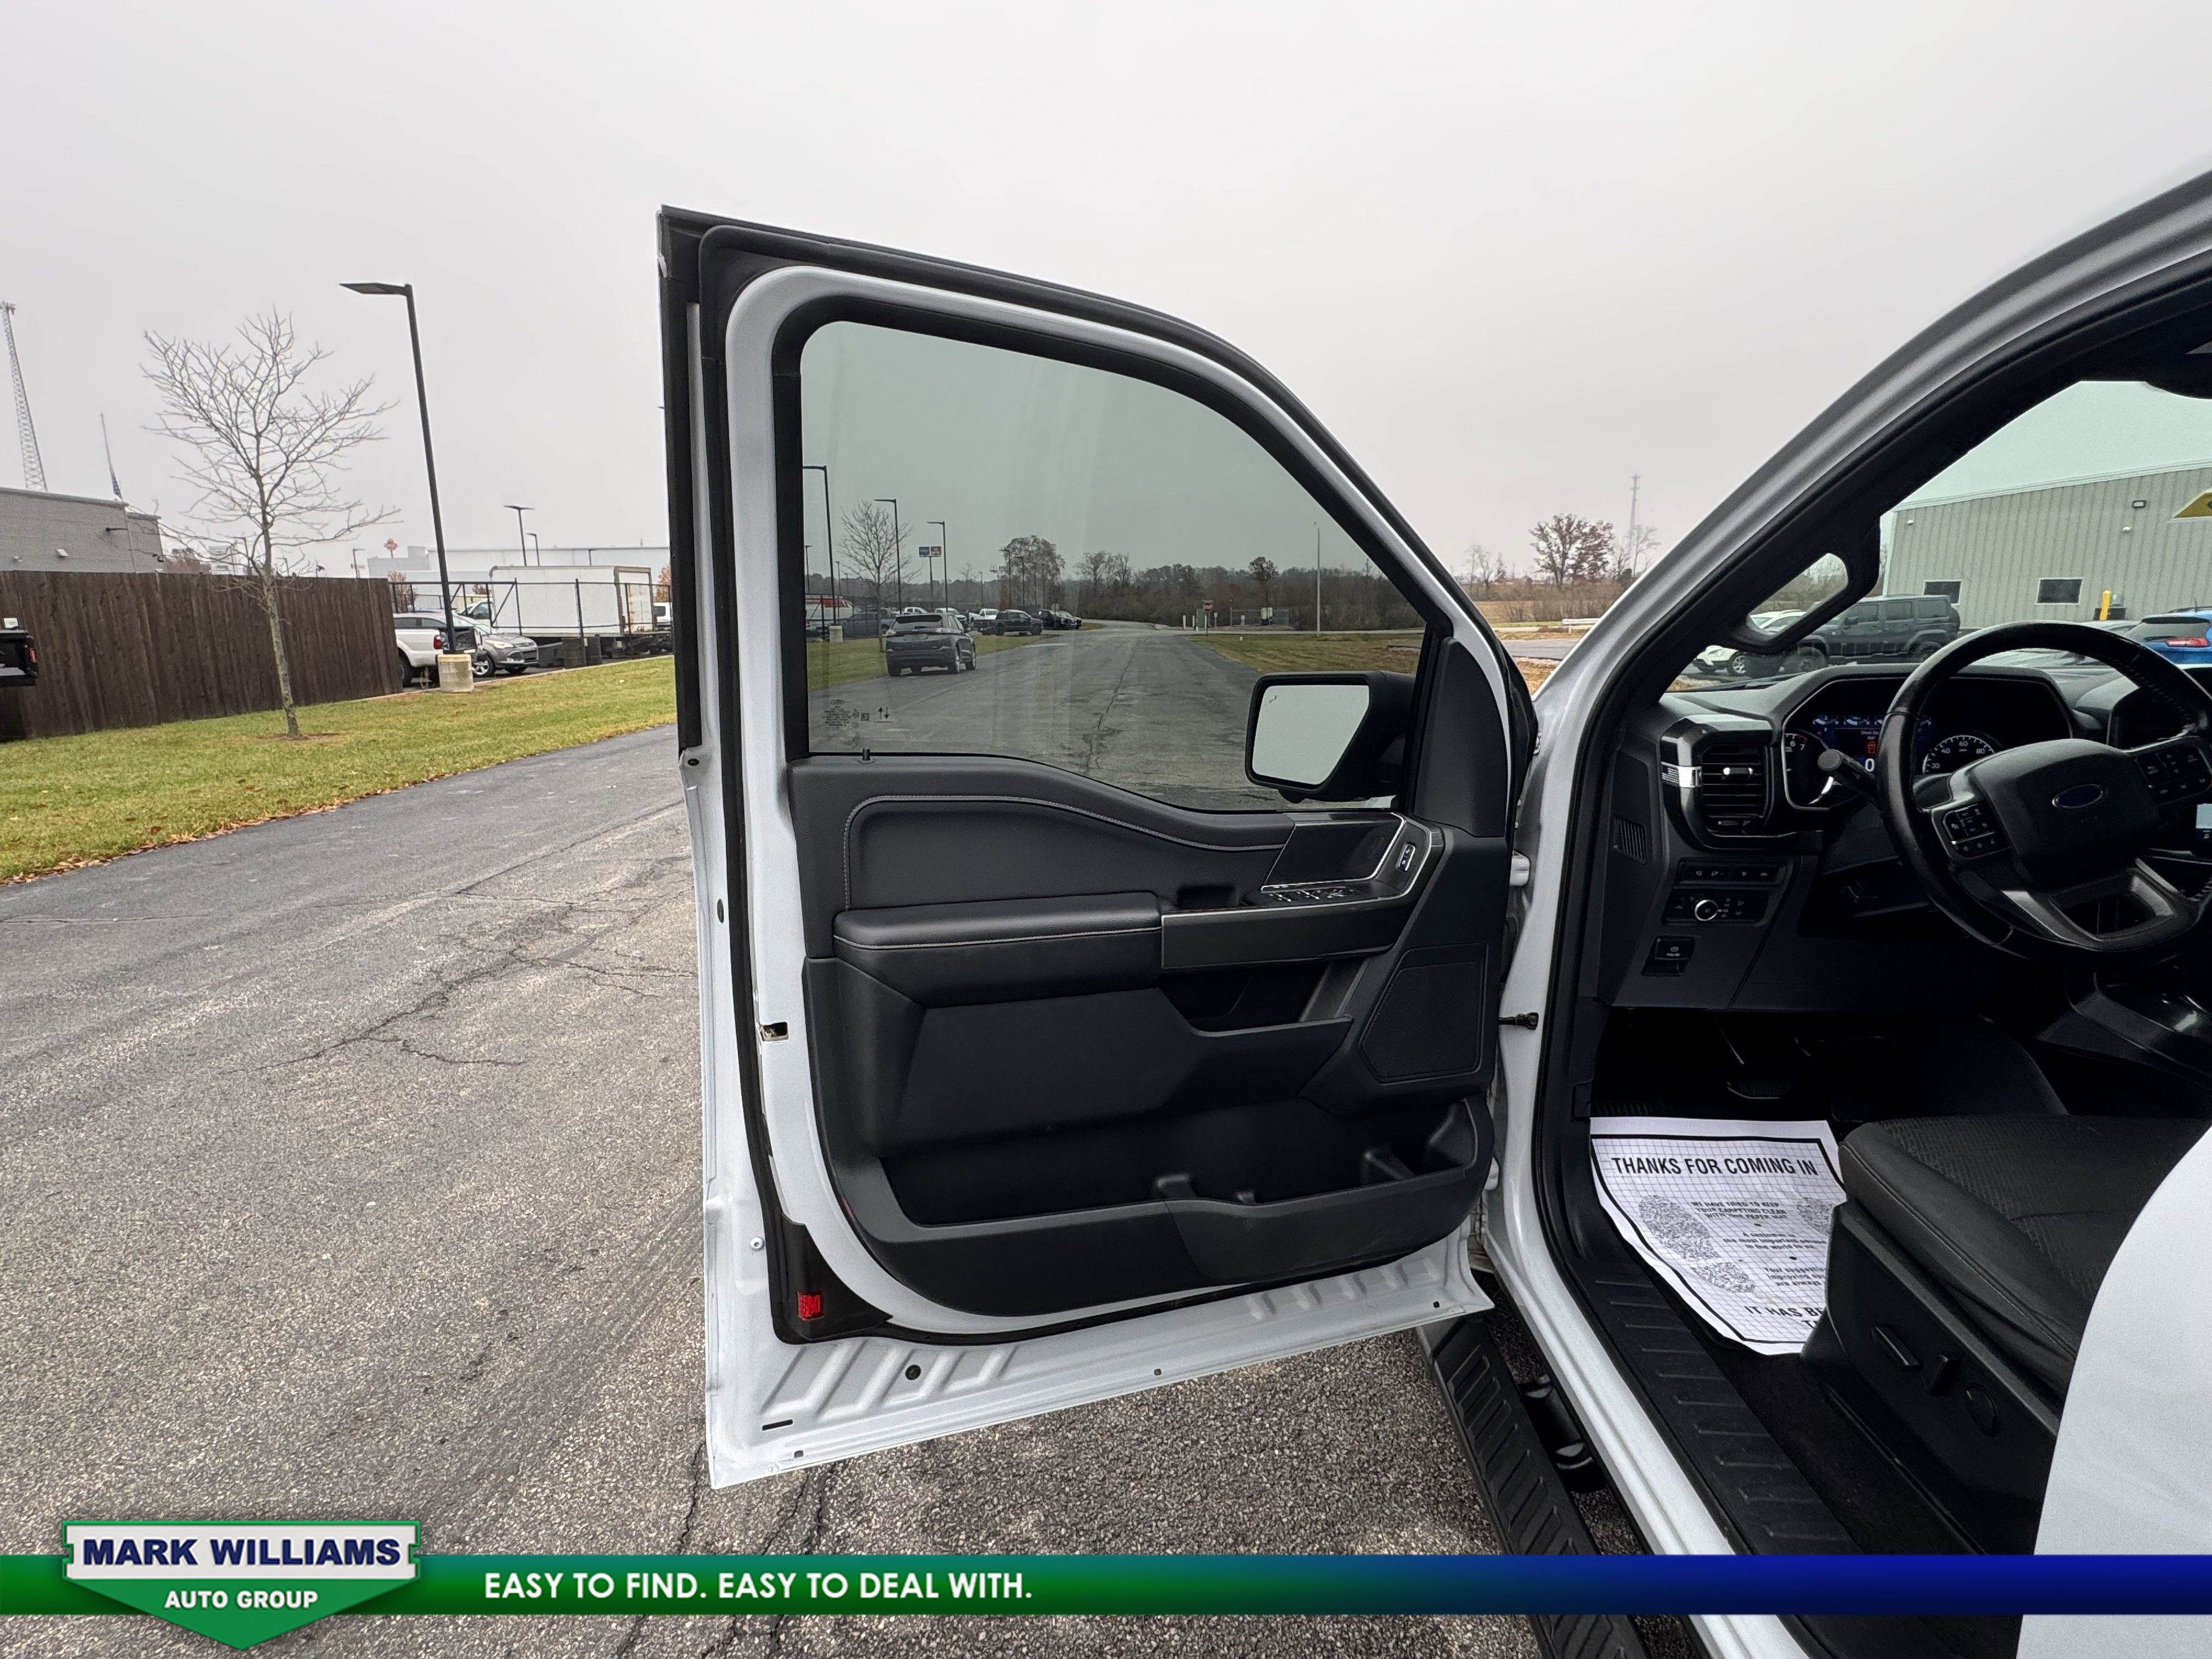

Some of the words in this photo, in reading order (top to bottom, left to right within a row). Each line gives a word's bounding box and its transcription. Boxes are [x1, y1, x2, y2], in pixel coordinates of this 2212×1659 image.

[1865, 758, 1875, 772] 0
[1611, 1157, 1681, 1175] THANKS
[1684, 1158, 1722, 1175] FOR
[1724, 1158, 1796, 1175] COMING
[1797, 1159, 1819, 1176] IN
[1743, 1306, 1762, 1314] IT
[1764, 1307, 1803, 1317] HAS
